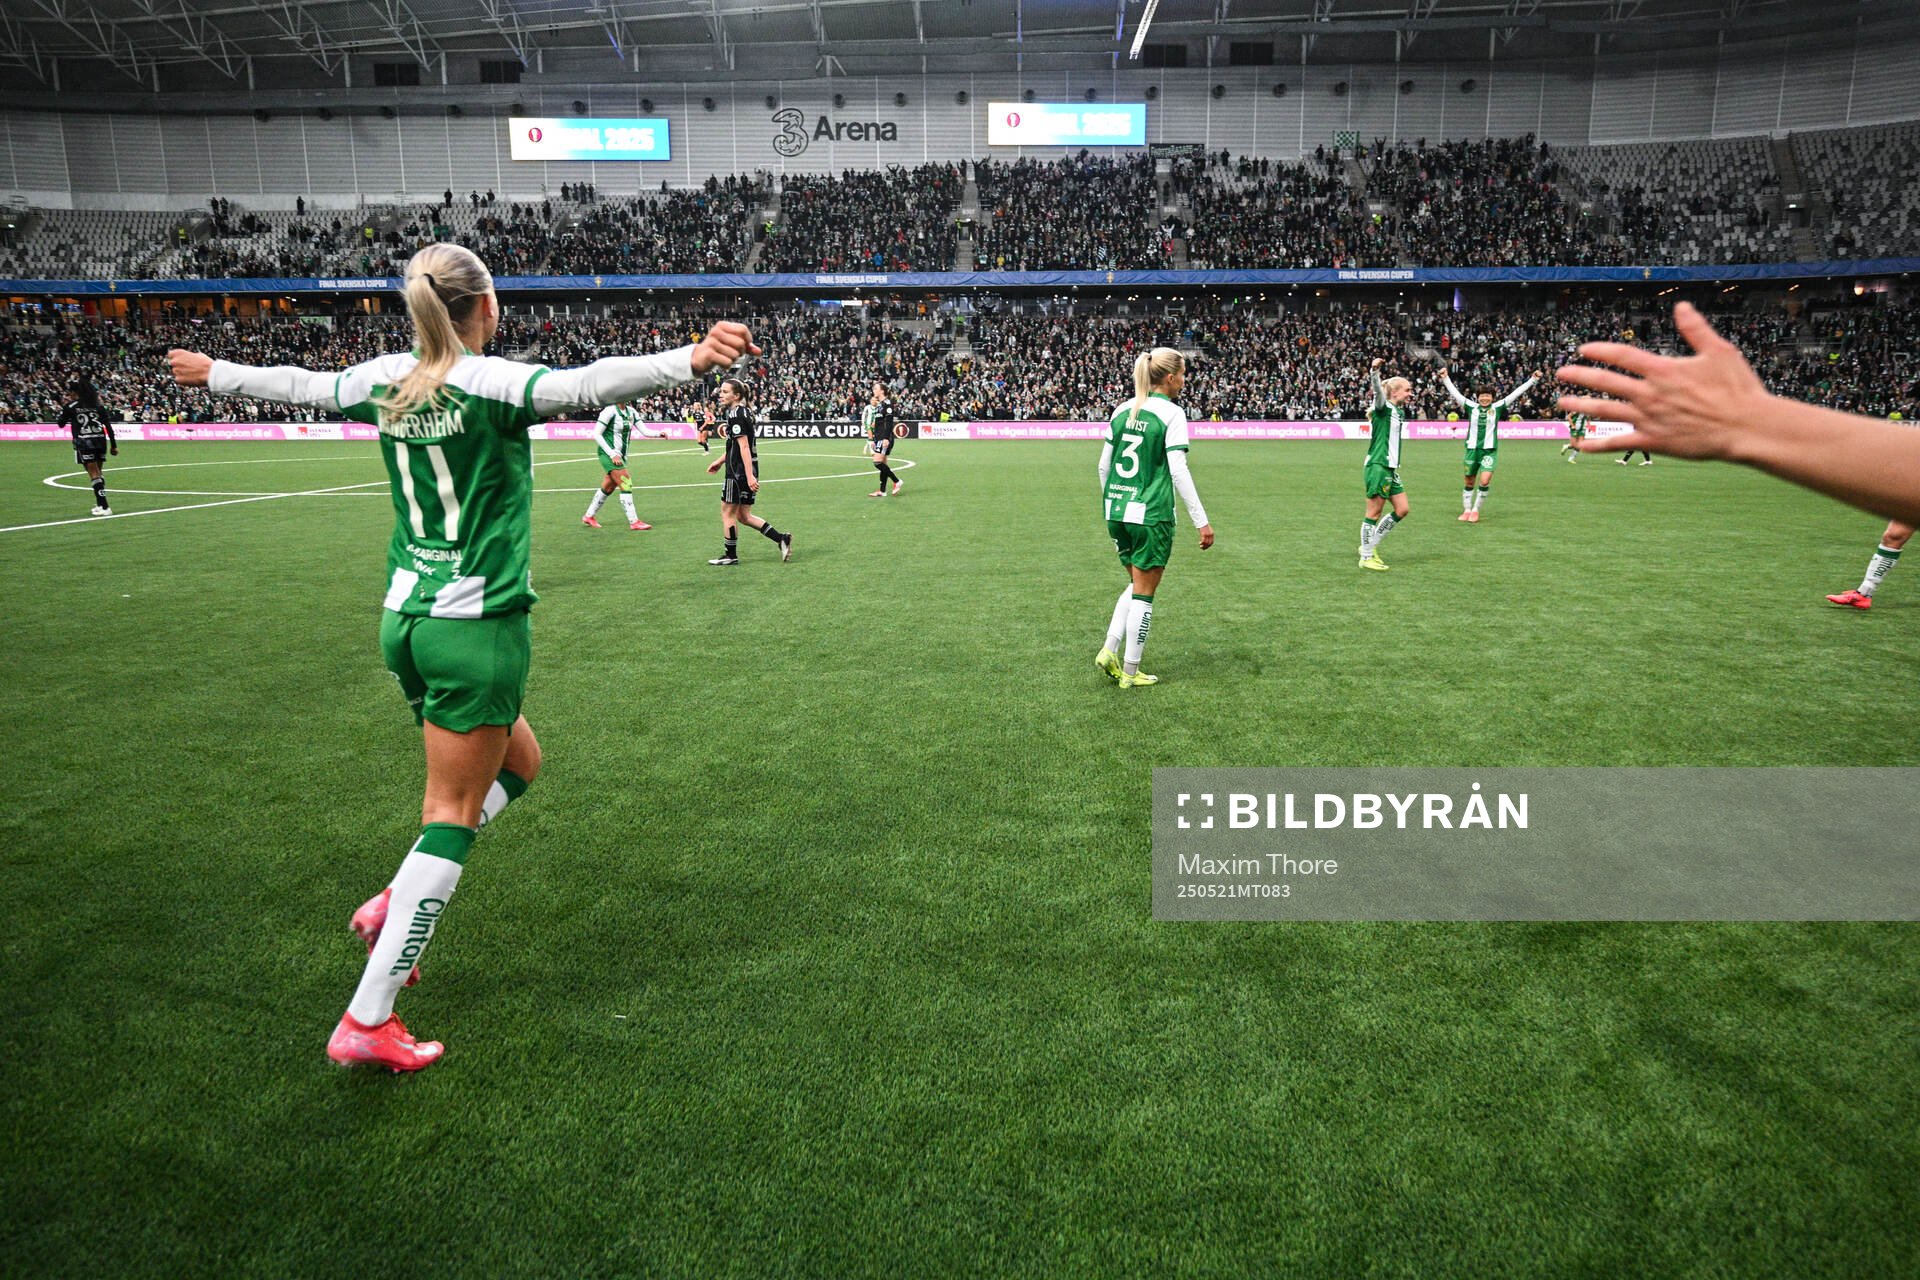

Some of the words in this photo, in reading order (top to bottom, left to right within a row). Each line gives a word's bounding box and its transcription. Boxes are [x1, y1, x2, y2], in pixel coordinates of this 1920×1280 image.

[813, 116, 897, 141] Arena
[605, 128, 655, 150] 2025
[816, 275, 835, 284] FINAL
[835, 275, 866, 284] SVENSKA
[866, 275, 888, 284] CUPEN
[1338, 270, 1358, 279] FINAL
[1358, 270, 1390, 279] SVENSKA
[1390, 270, 1414, 279] CUPEN
[319, 280, 337, 288] FINAL
[337, 280, 366, 288] SVENSKA
[366, 280, 387, 288] CUPEN
[76, 413, 103, 434] 23
[754, 425, 822, 438] VENSKA
[824, 425, 868, 438] CUPE
[977, 426, 998, 436] Hela
[998, 427, 1028, 438] vägen
[1028, 426, 1047, 436] från
[1047, 427, 1088, 438] ungdom
[1194, 426, 1216, 436] Hela
[1217, 426, 1247, 438] vägen
[1247, 426, 1266, 436] från
[1266, 427, 1307, 438] ungdom
[1308, 426, 1320, 436] till
[1417, 426, 1439, 436] Hela
[1497, 427, 1532, 438] ngdom
[1115, 432, 1145, 479] 3
[395, 441, 461, 542] 11
